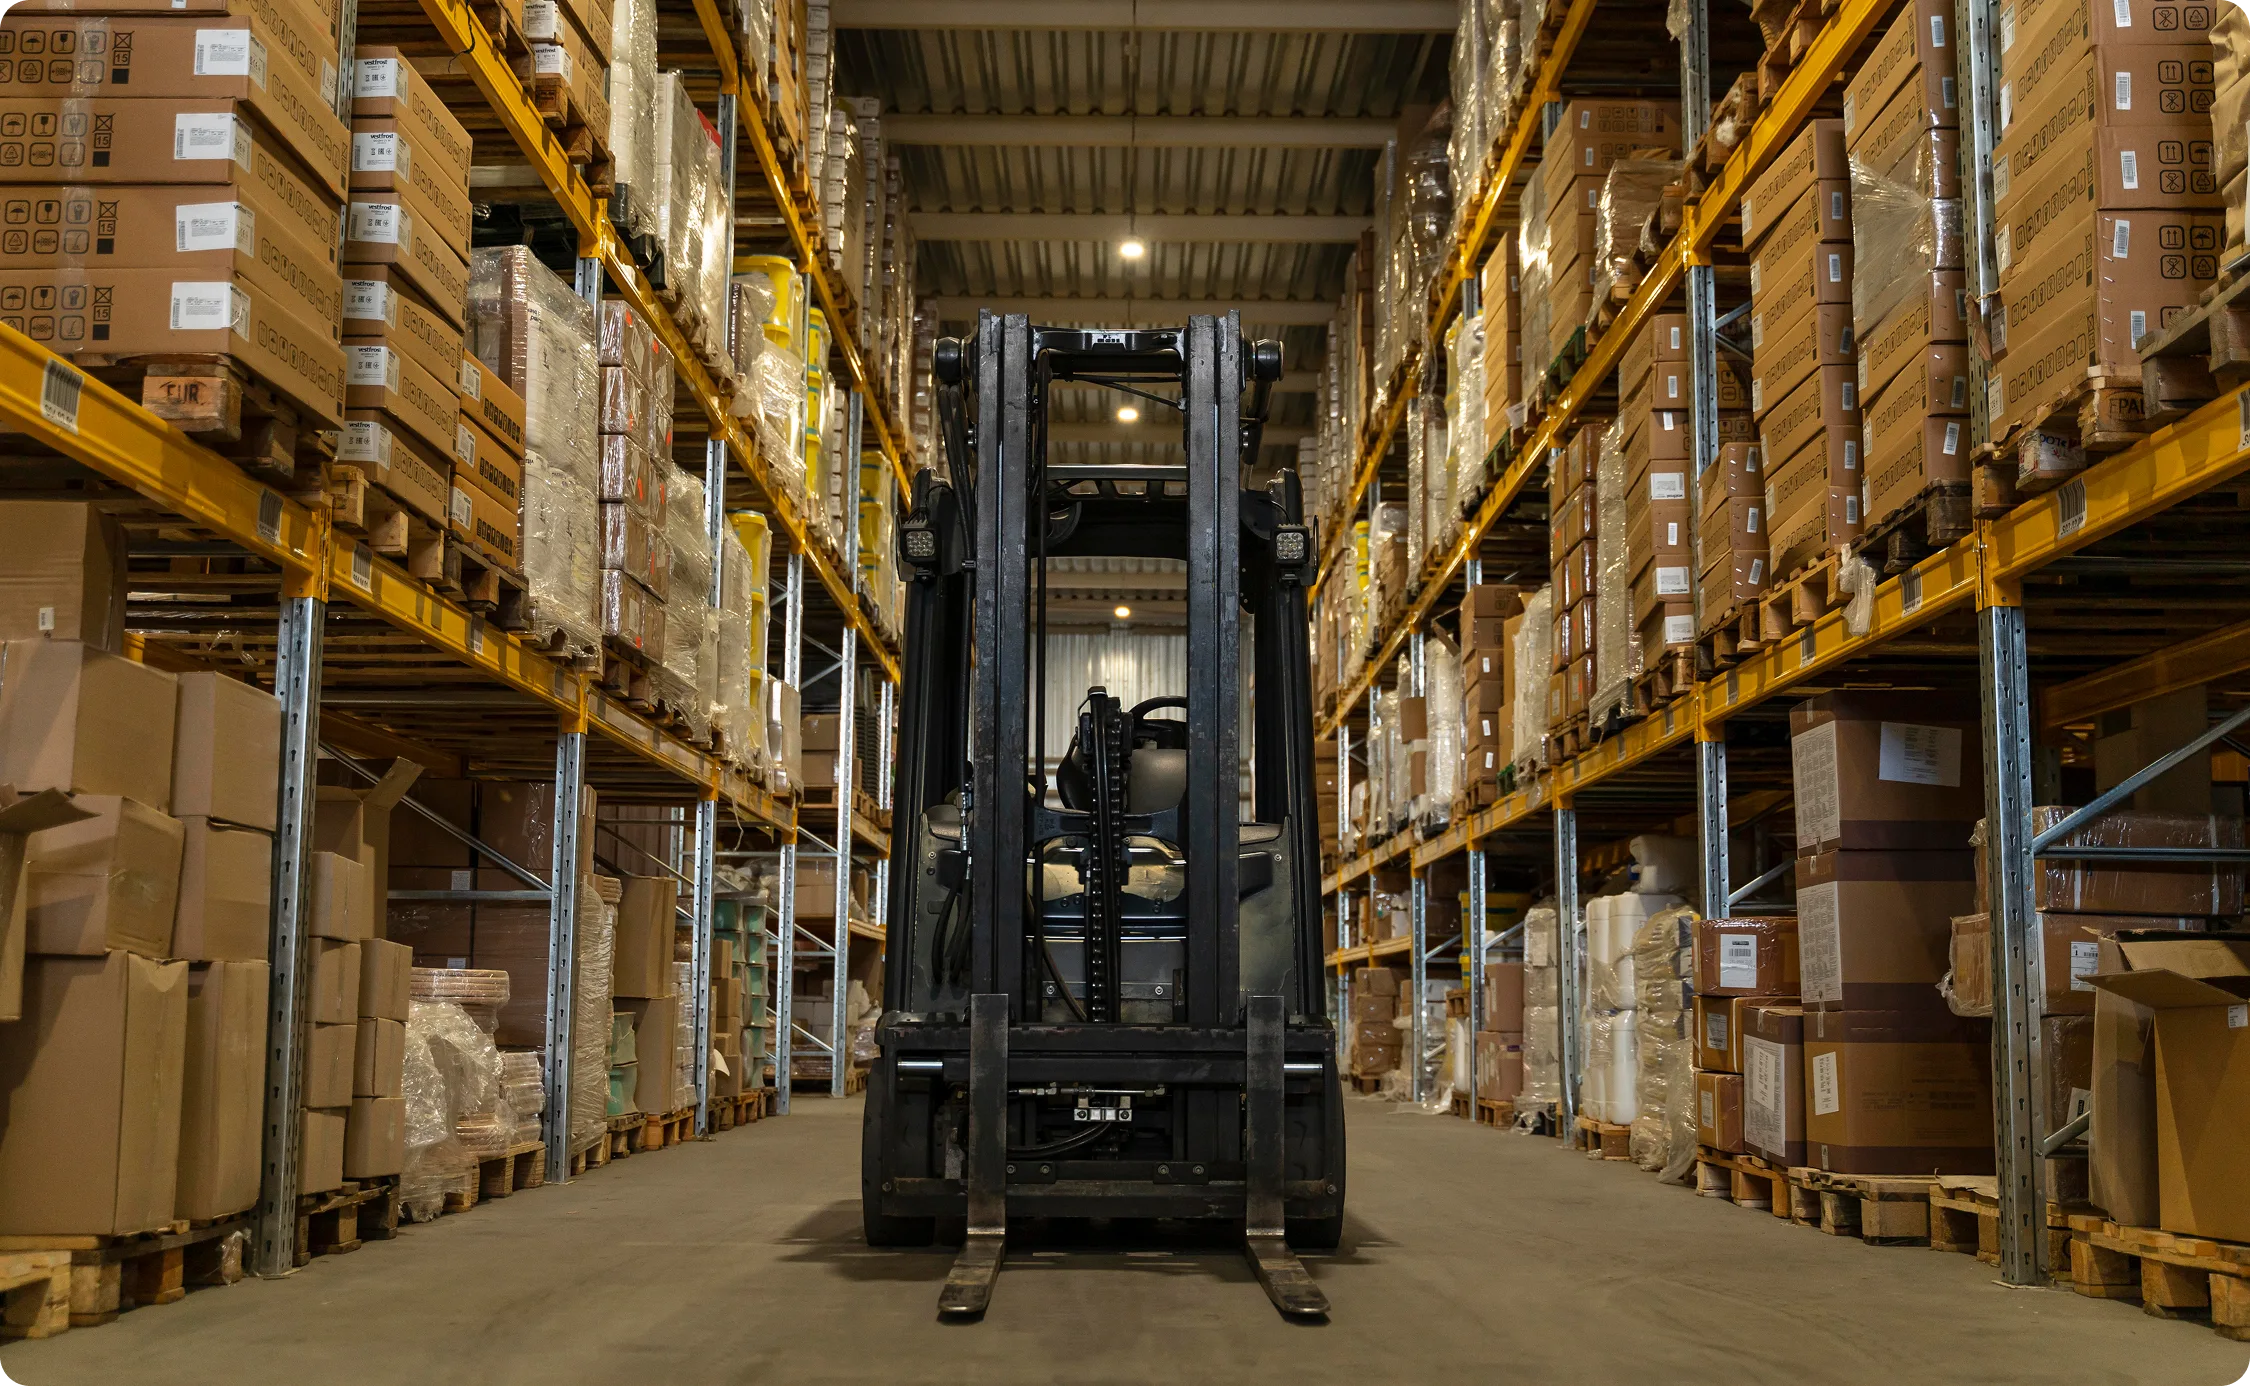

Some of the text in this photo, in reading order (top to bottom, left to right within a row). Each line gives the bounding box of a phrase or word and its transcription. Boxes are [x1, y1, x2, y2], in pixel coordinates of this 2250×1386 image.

[115, 53, 128, 62] 15
[97, 136, 109, 145] 15
[100, 223, 114, 232] 15
[96, 309, 109, 318] 15
[167, 383, 199, 404] EUR
